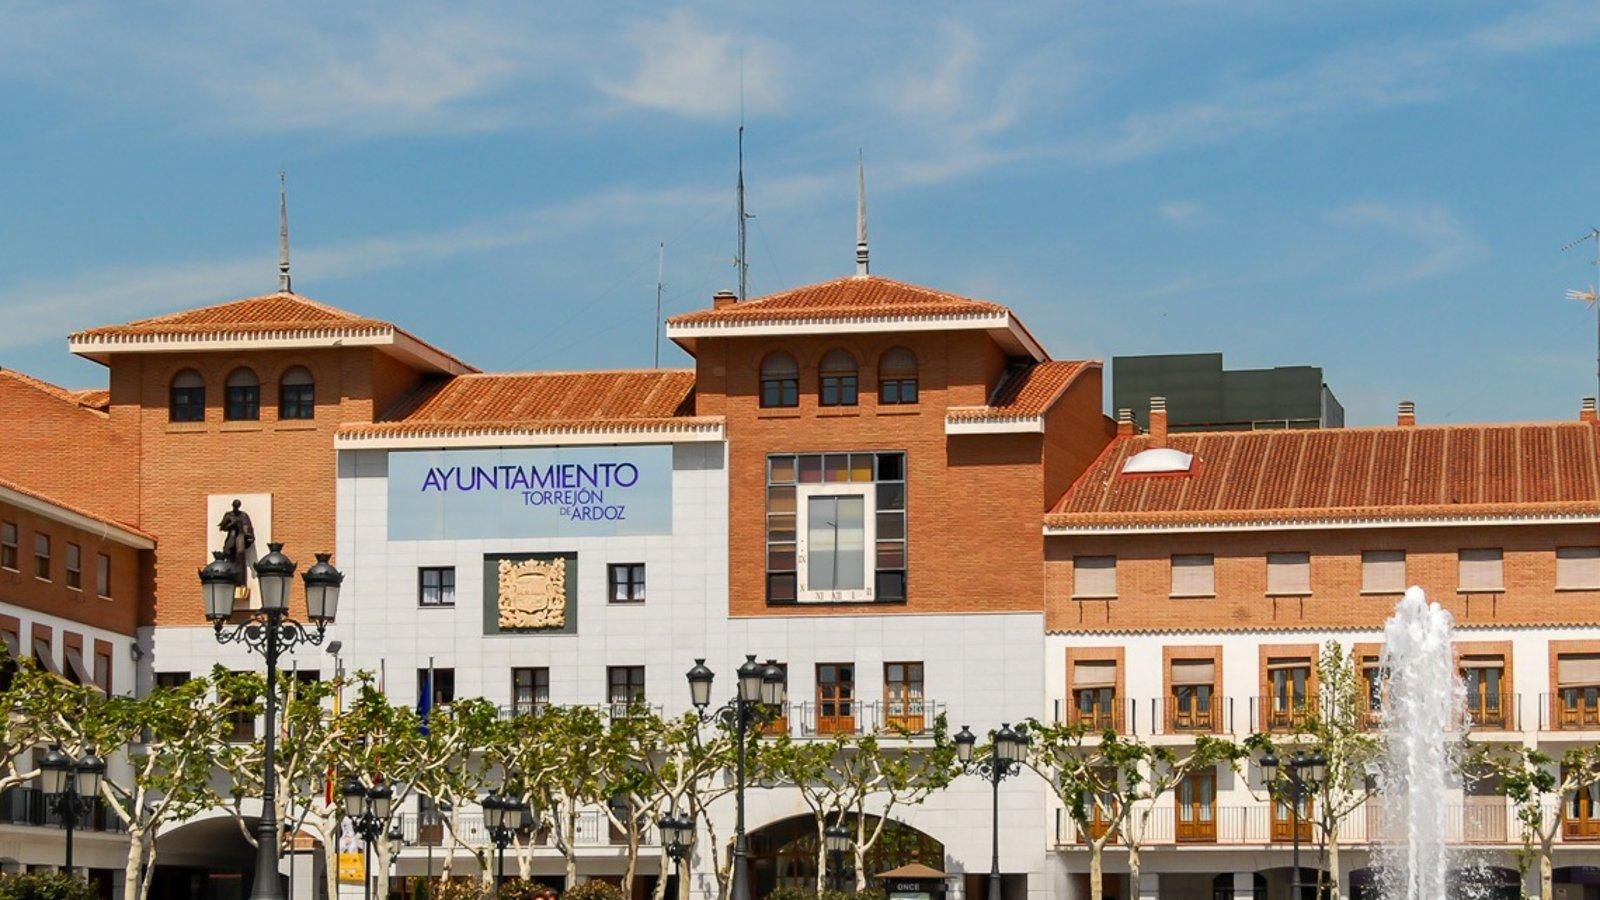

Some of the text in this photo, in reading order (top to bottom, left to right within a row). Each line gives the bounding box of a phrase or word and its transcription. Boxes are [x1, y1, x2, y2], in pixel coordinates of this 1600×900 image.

[421, 462, 639, 492] AYUNTAMIENTO
[521, 487, 603, 507] TORREJÓN
[559, 505, 625, 521] DE ARDOZ
[896, 883, 920, 891] ONCE
